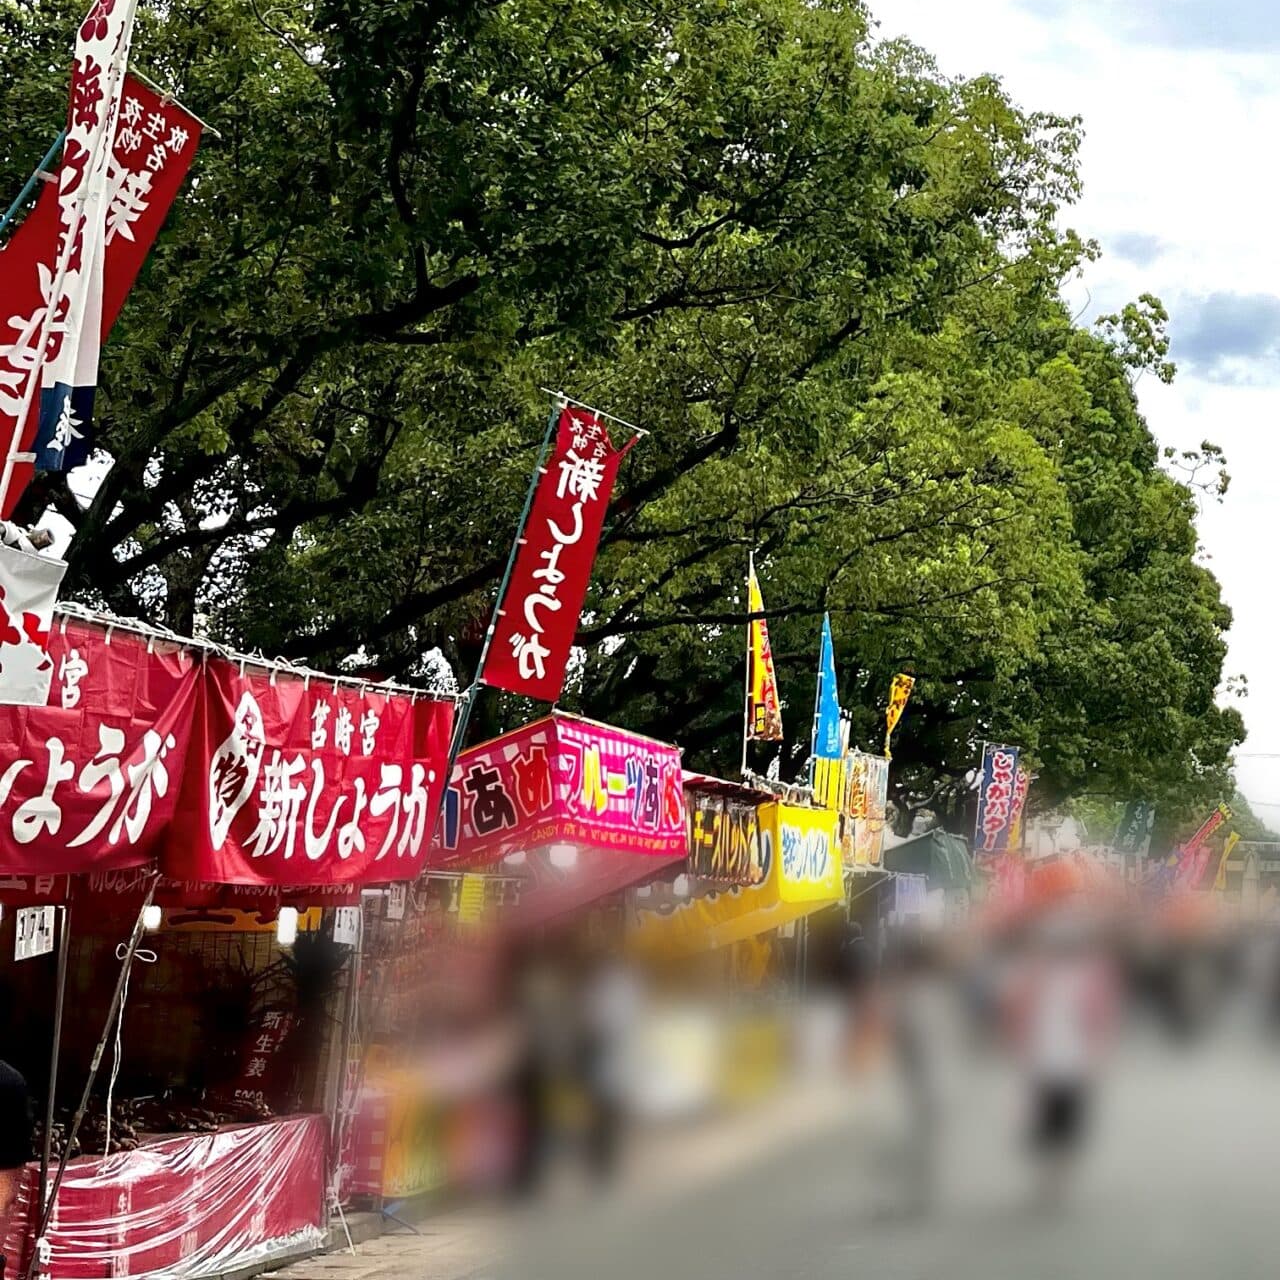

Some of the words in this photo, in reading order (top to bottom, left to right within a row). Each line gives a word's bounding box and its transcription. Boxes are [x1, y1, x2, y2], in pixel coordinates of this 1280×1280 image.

[241, 749, 435, 861] 新しょうが
[983, 752, 1014, 851] じゃがバター
